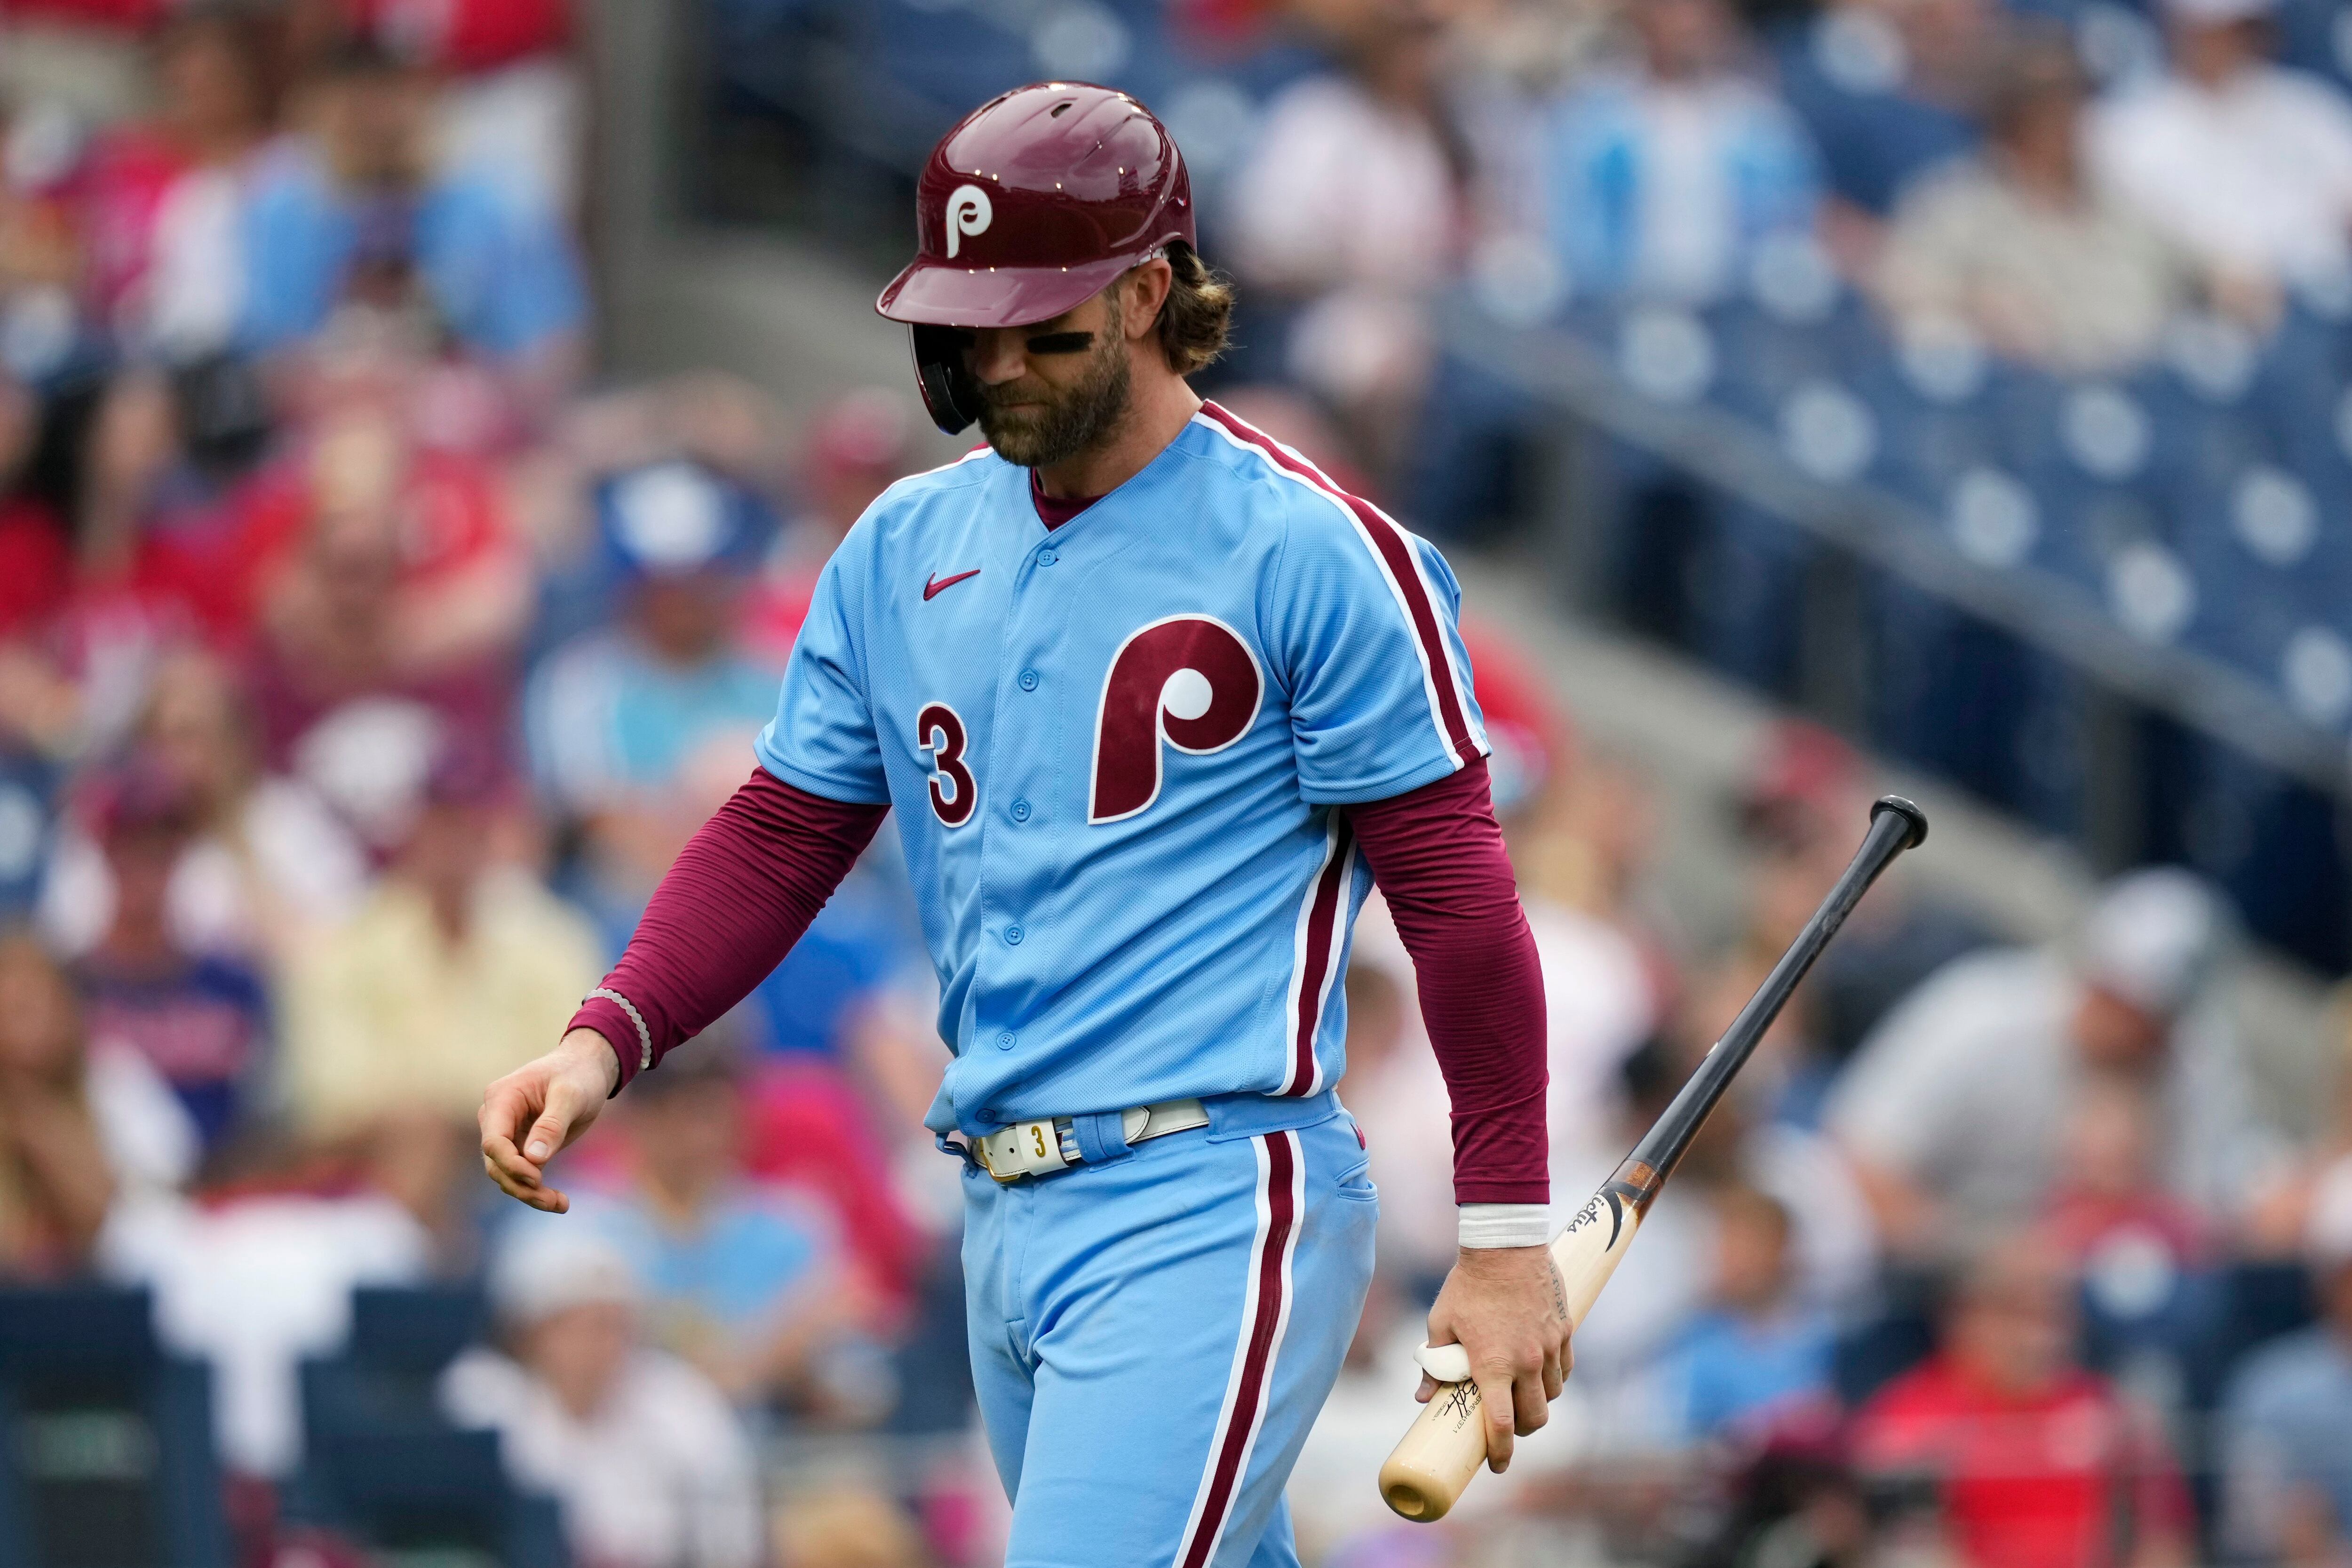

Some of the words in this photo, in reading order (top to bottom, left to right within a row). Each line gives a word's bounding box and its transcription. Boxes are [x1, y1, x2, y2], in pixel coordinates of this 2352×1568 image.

[946, 185, 993, 259] P
[1088, 613, 1265, 825] P
[916, 701, 978, 828] 3
[1031, 1125, 1046, 1158] 3
[1567, 1181, 1660, 1253] Victus
